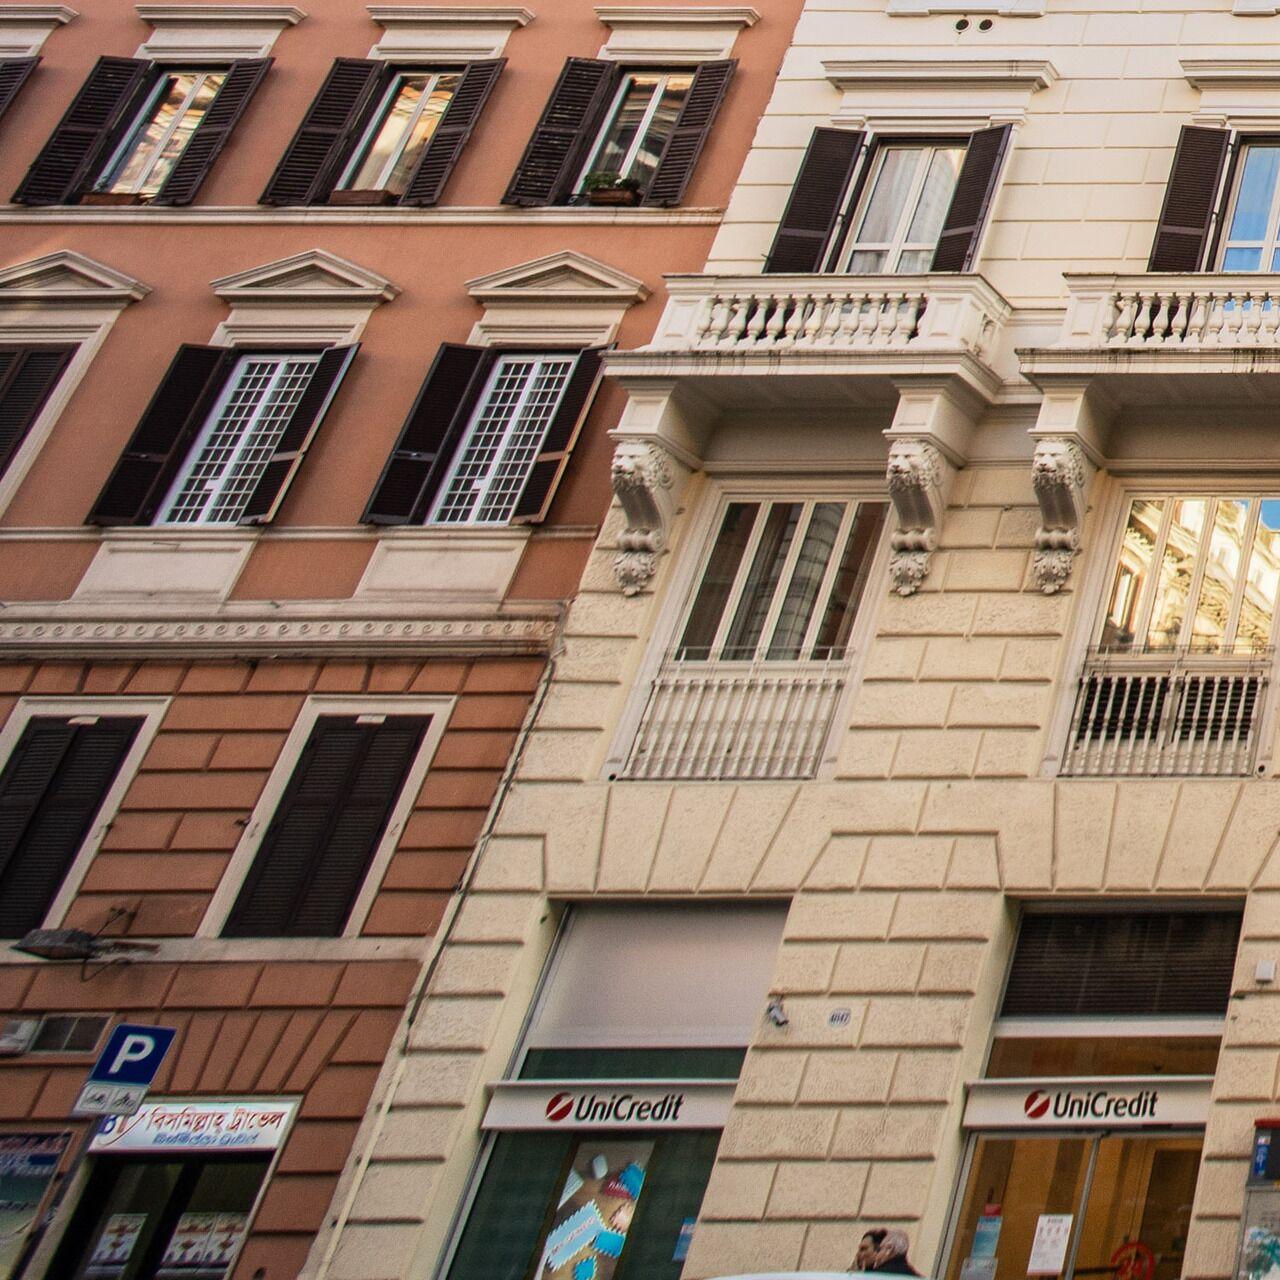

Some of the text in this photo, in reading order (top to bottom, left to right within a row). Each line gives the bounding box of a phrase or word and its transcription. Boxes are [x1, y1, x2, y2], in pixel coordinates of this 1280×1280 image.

[108, 1034, 155, 1074] P
[575, 1093, 685, 1121] UniCredit
[1053, 1091, 1159, 1118] UniCredit
